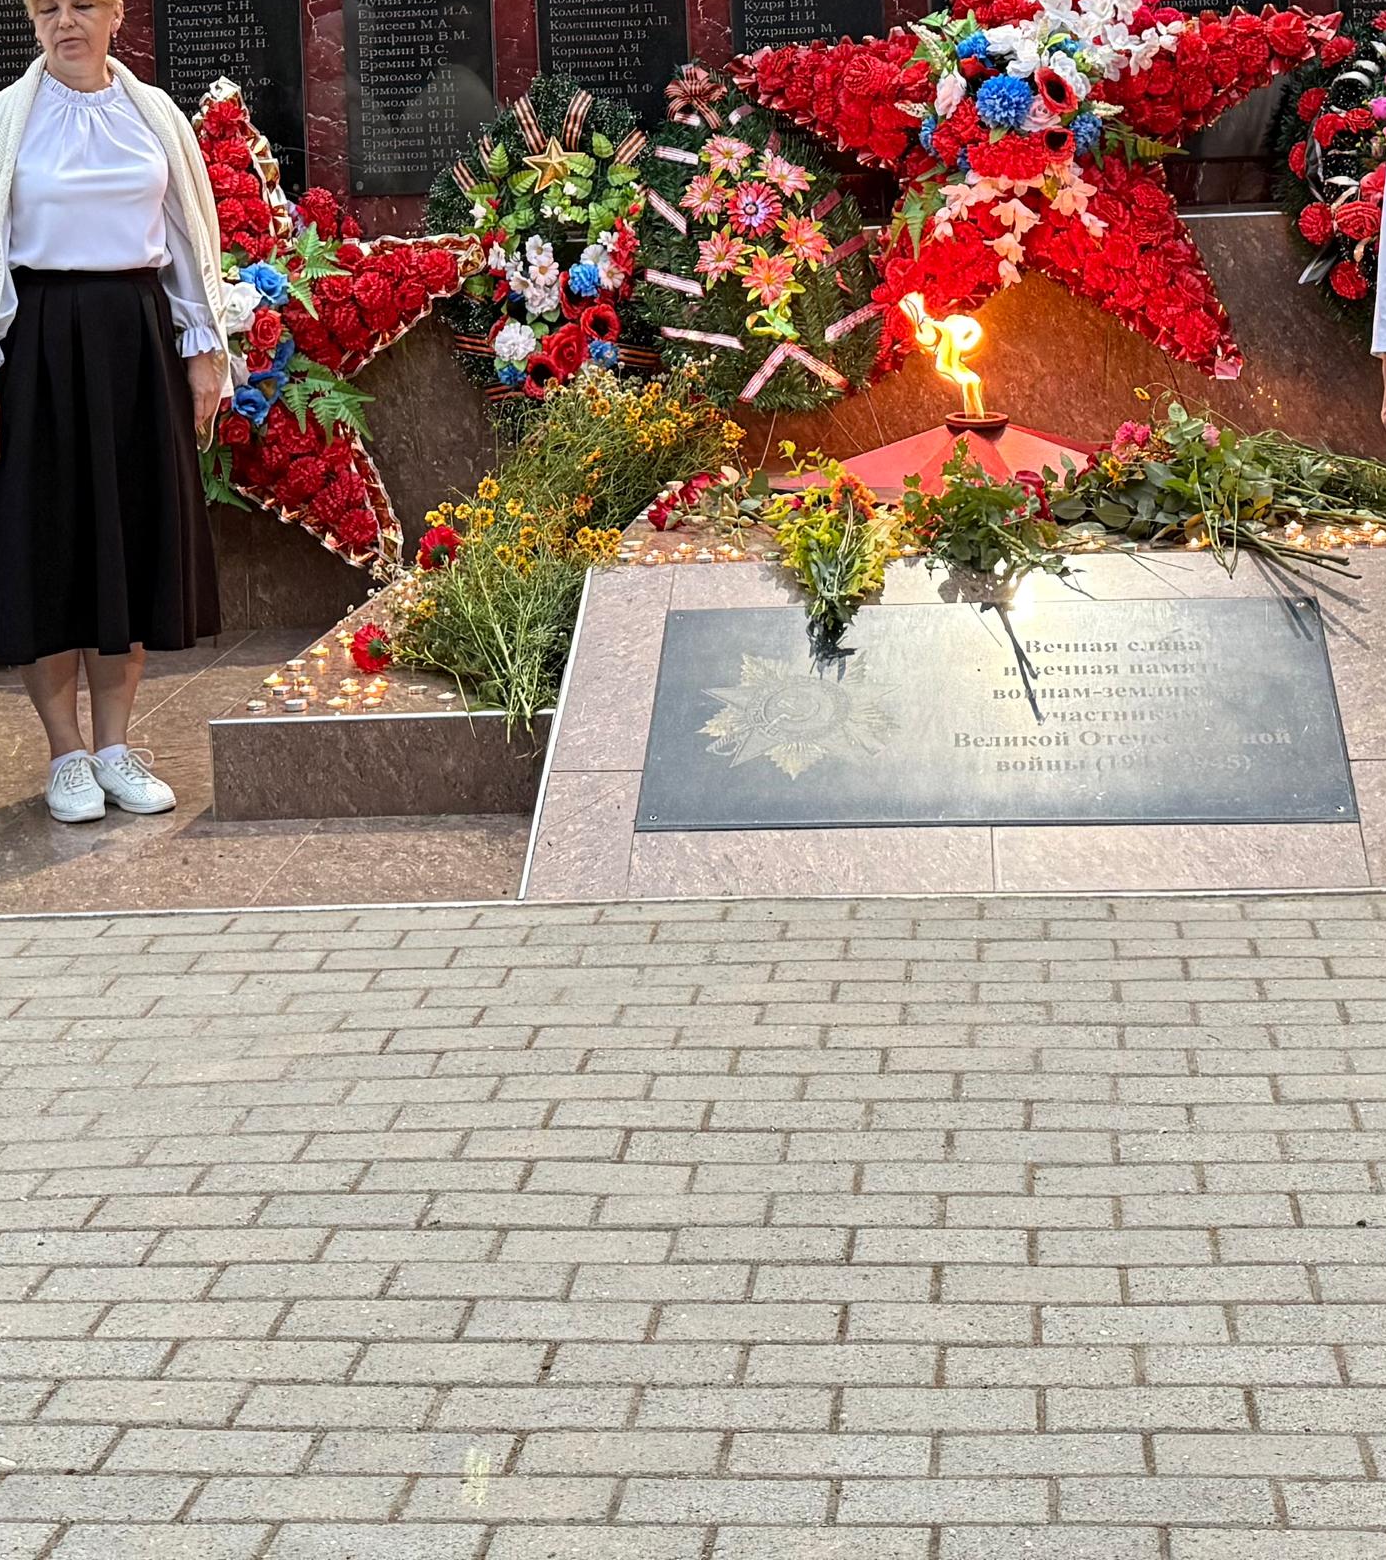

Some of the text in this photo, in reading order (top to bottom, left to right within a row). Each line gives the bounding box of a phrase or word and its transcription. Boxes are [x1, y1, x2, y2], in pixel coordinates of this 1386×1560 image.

[744, 0, 784, 11] Кудря
[550, 7, 625, 17] Колесников
[359, 22, 415, 32] Елисеев
[1025, 638, 1201, 653] Вечная слава
[1004, 666, 1017, 676] и
[954, 731, 1069, 748] Великой
[997, 756, 1086, 772] войны
